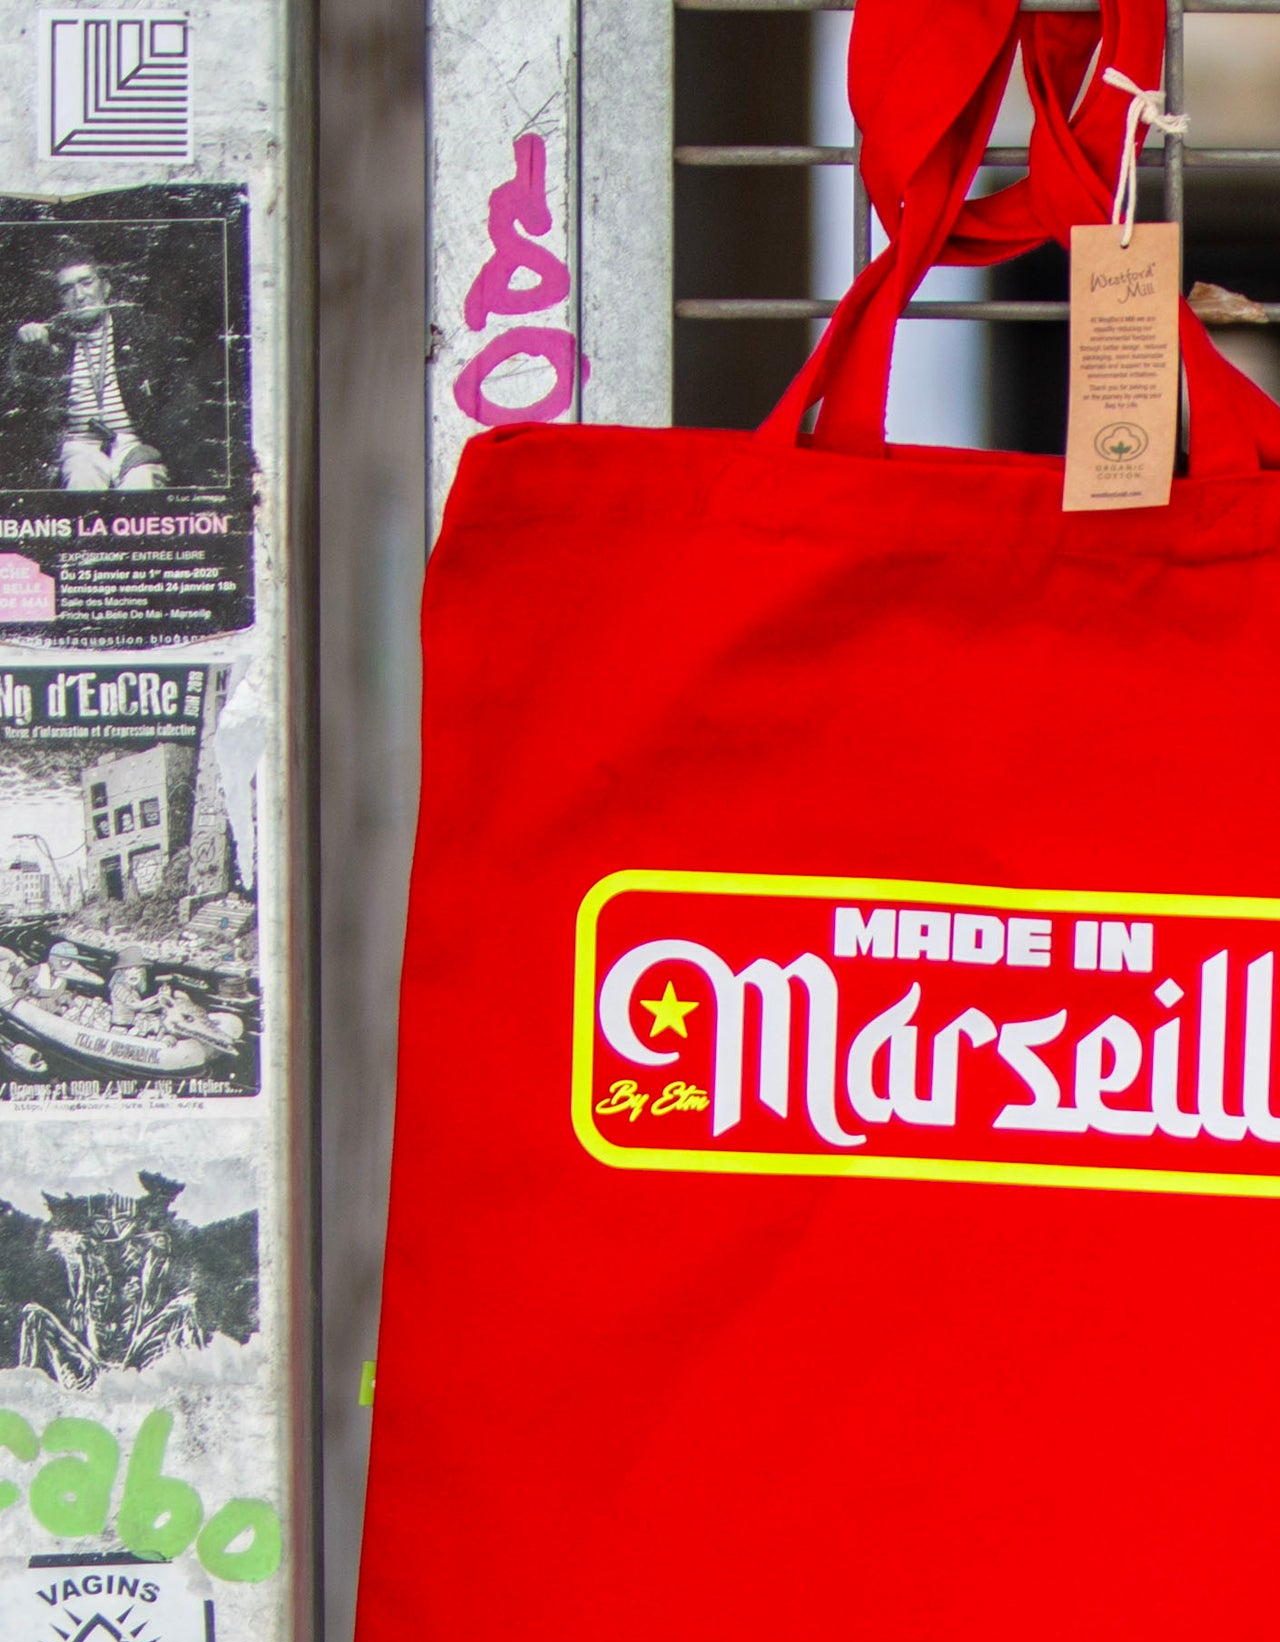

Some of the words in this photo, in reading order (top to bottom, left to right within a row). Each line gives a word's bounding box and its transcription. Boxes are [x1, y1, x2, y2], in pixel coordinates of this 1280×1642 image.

[78, 517, 107, 536] LA
[112, 516, 228, 536] QUESTION
[132, 550, 174, 561] ENTRÉE
[176, 551, 206, 561] LIBRE
[61, 570, 75, 581] Du
[79, 570, 91, 580] 25
[93, 569, 130, 582] janvier
[132, 571, 146, 580] au
[193, 568, 219, 578] 2020
[61, 584, 117, 596] Vernissage
[119, 583, 164, 593] vendredi
[165, 582, 179, 592] 24
[180, 582, 215, 594] janvier
[217, 581, 236, 591] 18h
[91, 725, 101, 737] et
[833, 906, 1052, 968] MADE
[1073, 921, 1154, 973] IN
[596, 1080, 648, 1121] By
[36, 1574, 161, 1607] VAGINS
